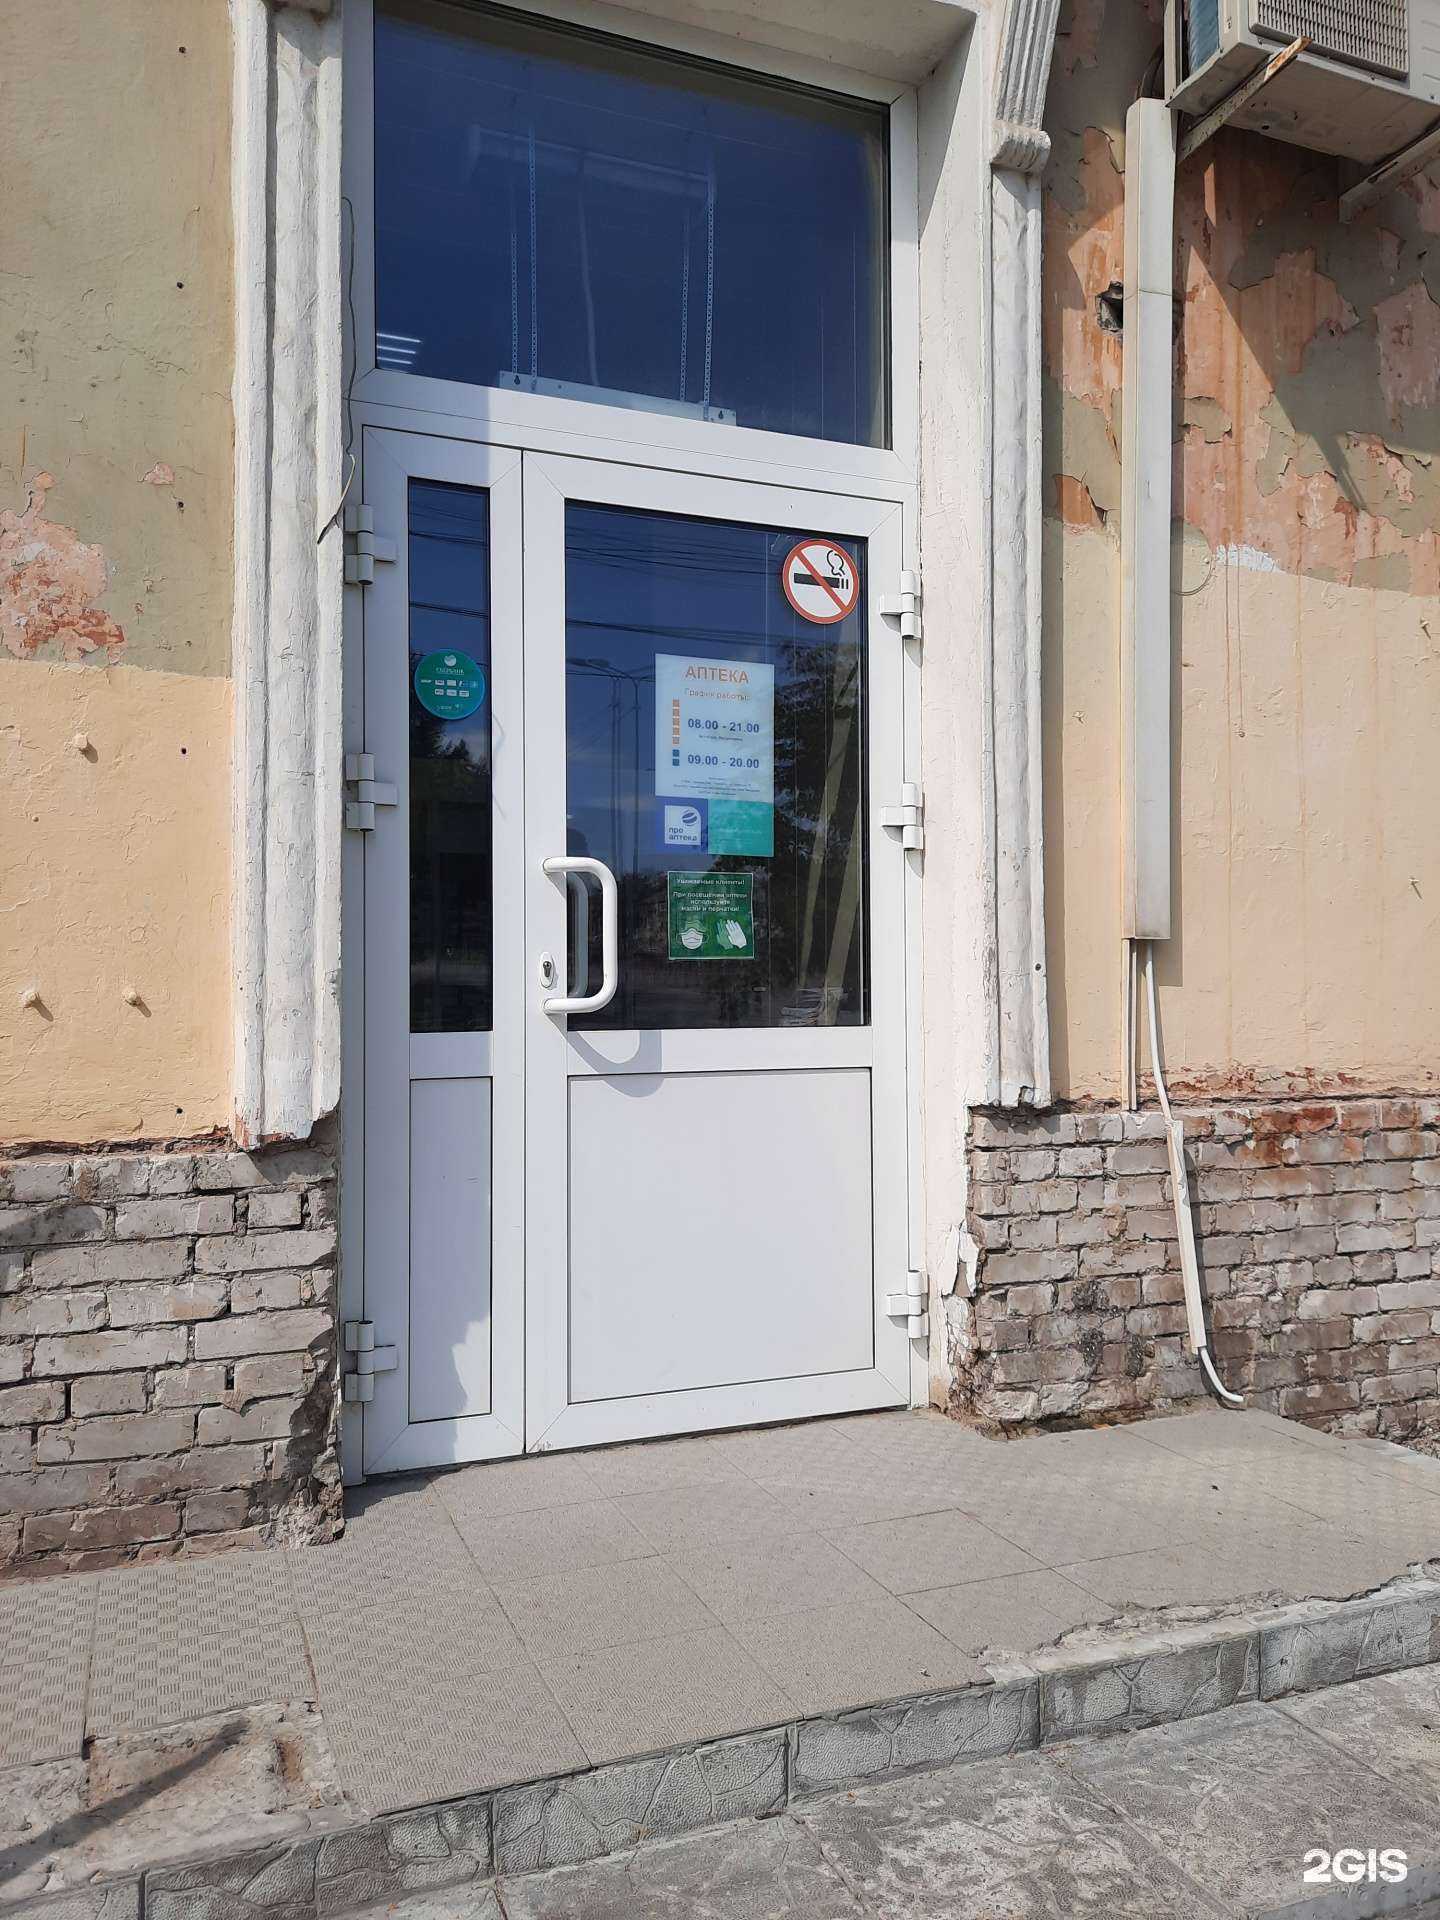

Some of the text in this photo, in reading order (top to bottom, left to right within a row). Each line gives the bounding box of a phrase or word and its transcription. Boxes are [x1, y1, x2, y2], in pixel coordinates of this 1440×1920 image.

[685, 665, 749, 684] АПТЕКА
[687, 718, 719, 730] 08.00
[729, 721, 760, 733] 21.00
[687, 754, 719, 766] 09.00
[729, 757, 760, 769] 20.00
